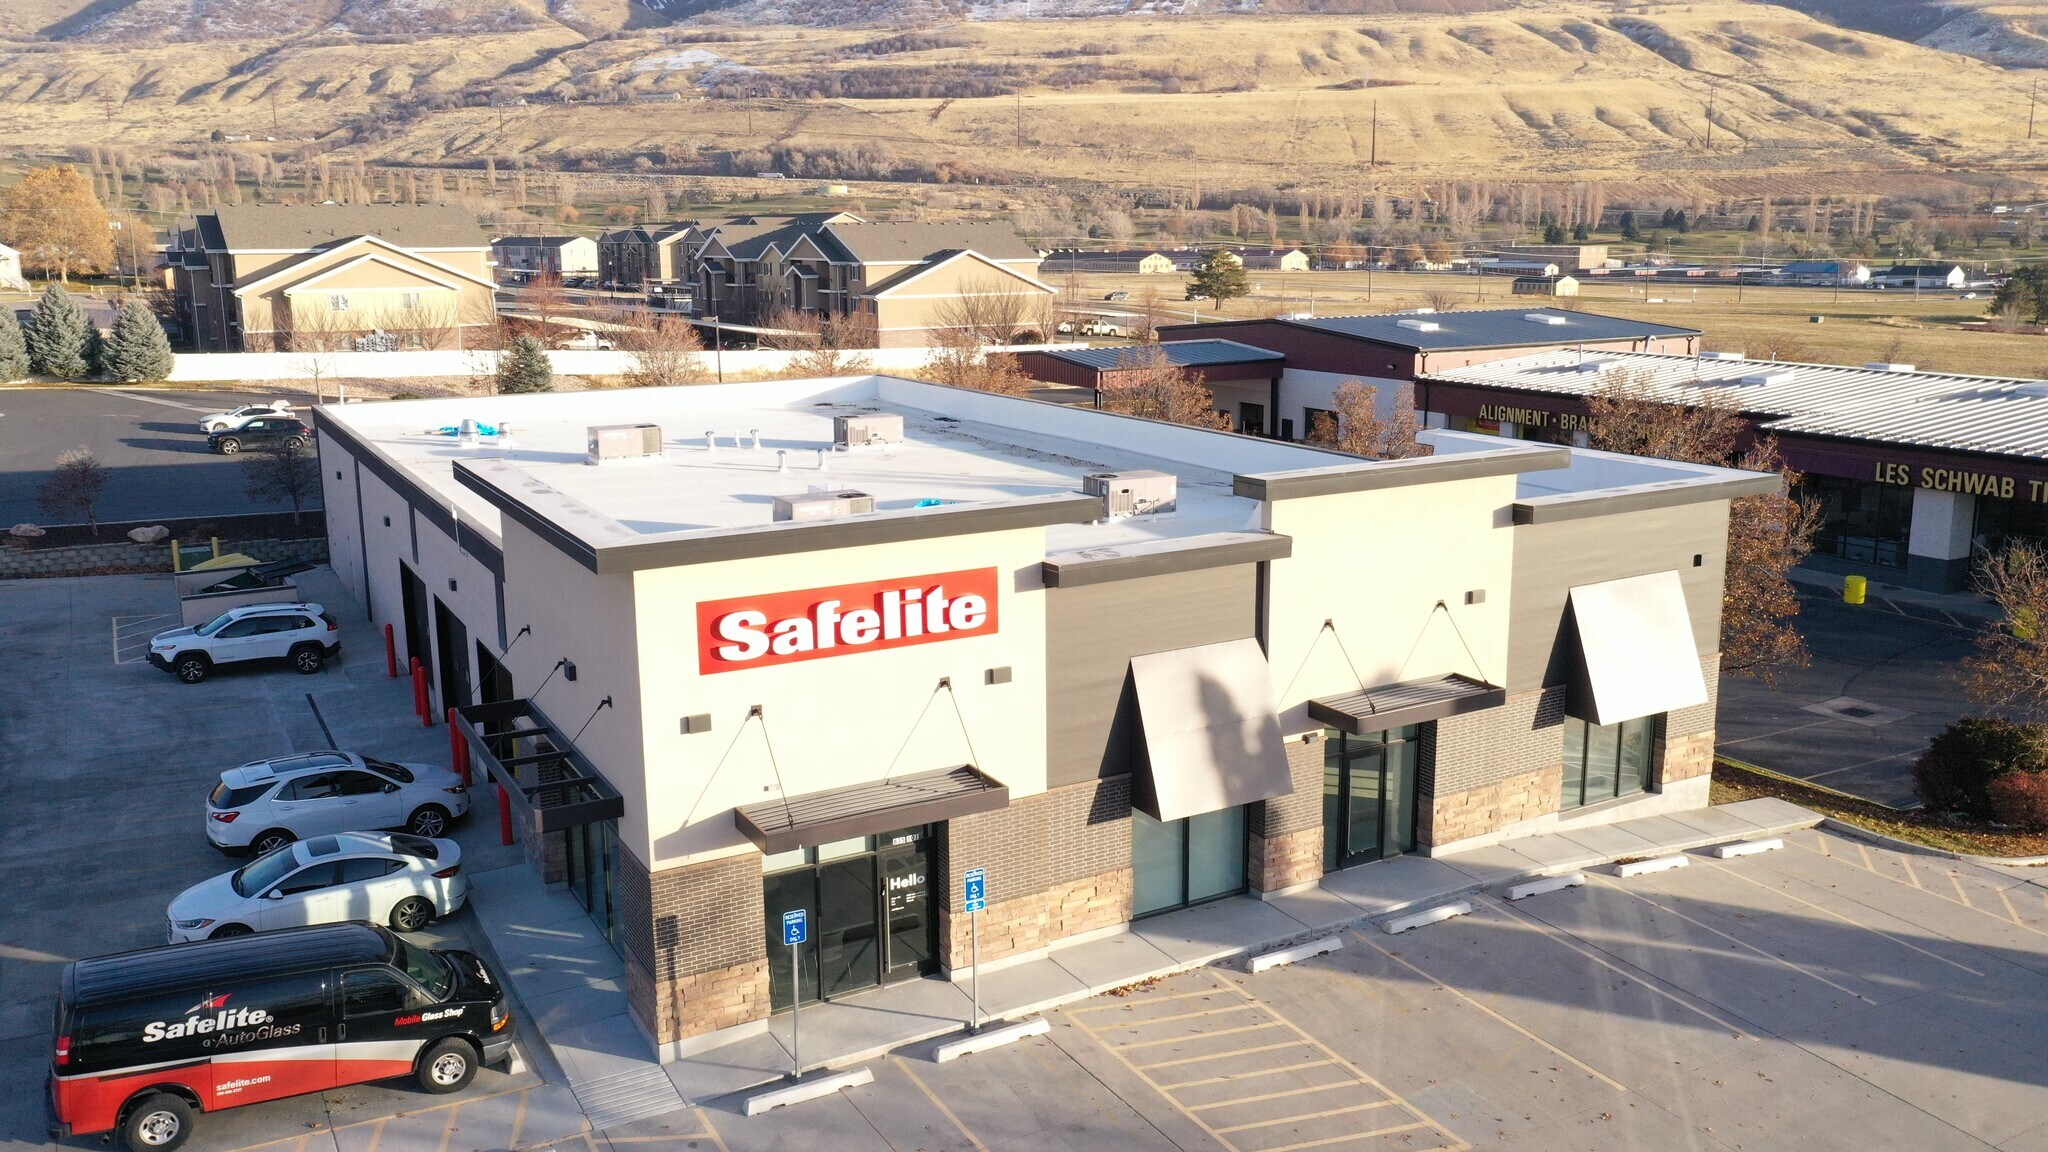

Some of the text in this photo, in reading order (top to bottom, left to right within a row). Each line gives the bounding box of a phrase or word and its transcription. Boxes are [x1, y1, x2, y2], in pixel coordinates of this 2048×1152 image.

[1479, 404, 1549, 427] ALIGNMENT
[1875, 462, 1909, 486] LES
[1921, 467, 2015, 499] SCHWAB
[711, 585, 987, 662] Safelite
[890, 873, 925, 890] Hello
[394, 1009, 464, 1026] Mobile Glass Shop
[215, 1023, 300, 1048] AutoGlass
[216, 1075, 271, 1091] safelite.com
